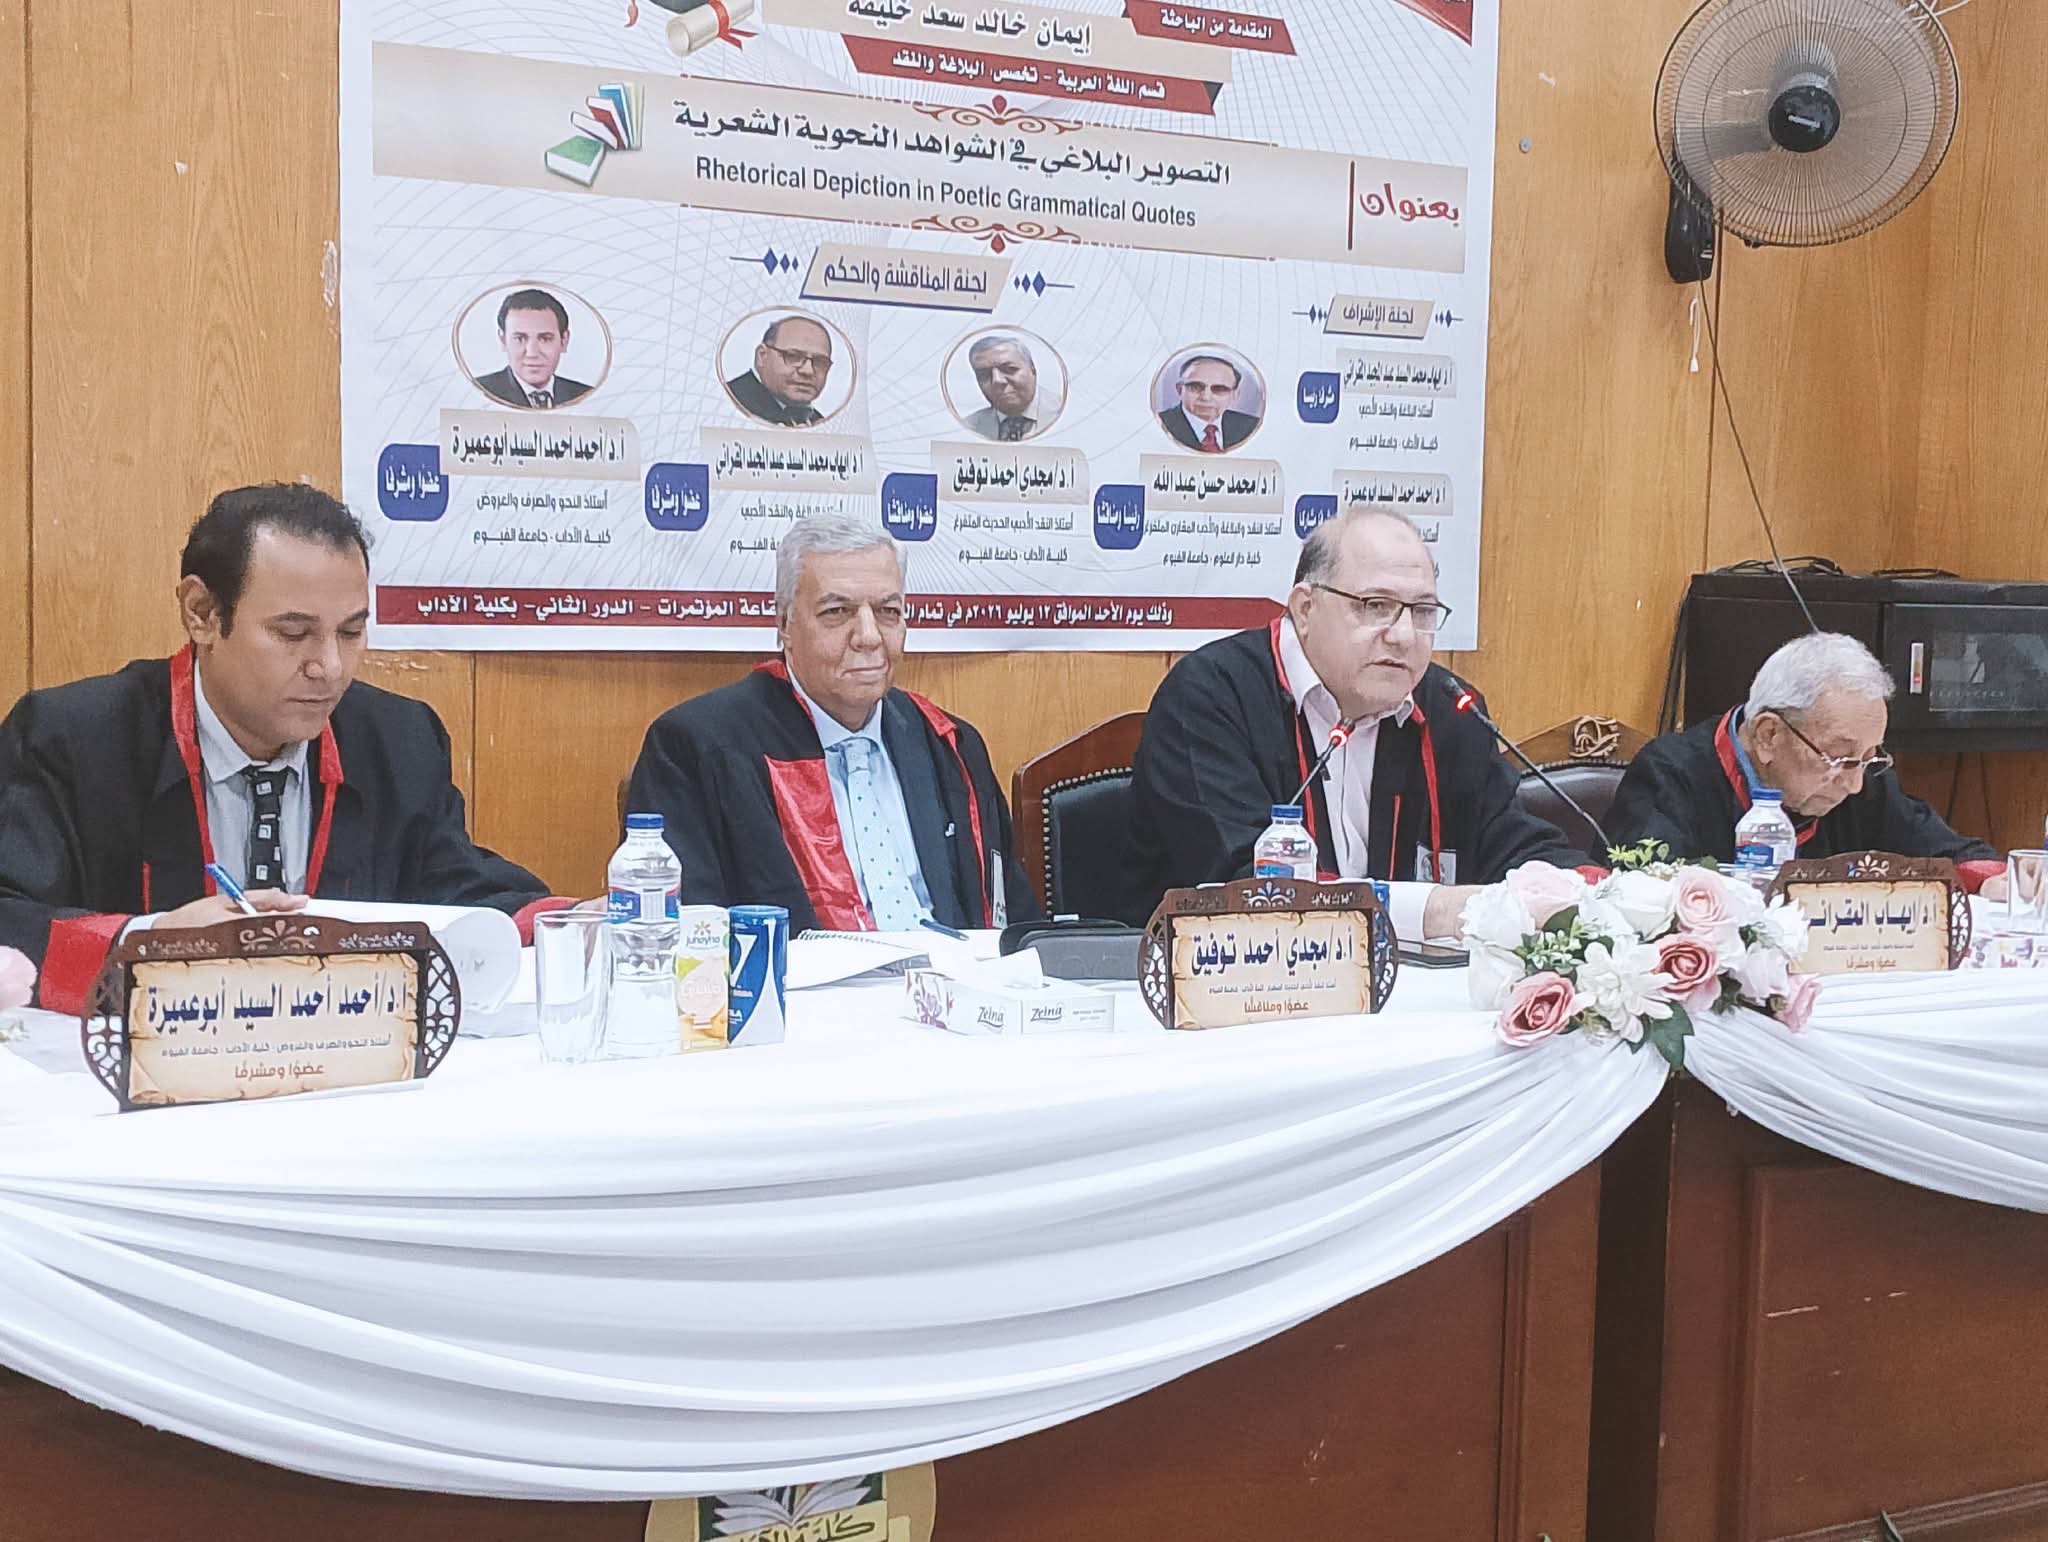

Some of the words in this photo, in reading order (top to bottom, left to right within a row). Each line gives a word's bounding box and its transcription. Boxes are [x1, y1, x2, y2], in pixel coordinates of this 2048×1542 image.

[922, 0, 964, 28] سعد
[975, 10, 1026, 36] خالد
[1160, 9, 1206, 31] الباحثة
[1036, 19, 1091, 54] إيمان
[1208, 17, 1226, 36] من
[1228, 19, 1272, 39] المقدمة
[892, 51, 935, 73] والنقد
[939, 54, 984, 76] البلاغة
[1057, 69, 1101, 92] العربية
[1107, 76, 1134, 95] اللغة
[1138, 80, 1165, 99] قسم
[674, 100, 789, 137] الشعرية
[795, 115, 898, 150] النحوية
[905, 132, 1004, 163] الشواهد
[1010, 137, 1036, 169] في
[1040, 145, 1130, 178] البلاغي
[1134, 158, 1231, 186] التصوير
[696, 156, 806, 189] Rhetorical
[813, 168, 910, 199] Depiction
[917, 179, 934, 202] in
[940, 182, 1001, 208] Poetic
[1008, 188, 1125, 221] Grammatical
[1131, 201, 1196, 227] Quotes
[1360, 183, 1459, 228] بعنوان
[824, 256, 880, 292] والحكم
[884, 259, 949, 293] المناقشة
[954, 268, 986, 300] لجنة
[1343, 301, 1385, 330] الإشراف
[1389, 306, 1413, 329] لجنة
[510, 430, 543, 465] السيد
[544, 426, 572, 459] أحمد
[953, 458, 988, 493] توفيق
[990, 456, 1018, 487] أحمد
[1153, 465, 1173, 492] الله
[1175, 474, 1196, 500] عبد
[1198, 470, 1225, 500] حسن
[477, 492, 519, 512] والعروض
[521, 494, 556, 512] والصرف
[558, 494, 582, 511] النحو
[583, 490, 608, 510] أستاذ
[741, 497, 766, 520] الأدبي
[768, 502, 794, 521] والنقد
[1010, 511, 1034, 533] الأدبي
[1035, 515, 1053, 531] النقد
[1054, 511, 1073, 531] أستاذ
[518, 529, 548, 544] جامعة
[556, 528, 582, 544] الآداب
[994, 547, 1018, 561] جامعة
[1023, 546, 1045, 561] الآداب
[1163, 550, 1186, 567] الفيوم
[1186, 550, 1208, 564] جامعة
[417, 591, 467, 614] الآداب
[473, 593, 518, 620] بكلية
[591, 598, 634, 619] الدور
[657, 595, 734, 620] المؤتمرات
[917, 601, 943, 624] تمام
[947, 600, 962, 628] في
[1053, 601, 1091, 625] الموافق
[1094, 601, 1122, 622] الأحد
[1146, 601, 1173, 626] وذلك
[1005, 605, 1034, 625] يوليو
[1126, 607, 1143, 627] يوم
[1191, 931, 1237, 976] توفيق
[1244, 928, 1280, 965] أحمد
[233, 982, 283, 1031] السيد
[290, 973, 331, 1017] أحمد
